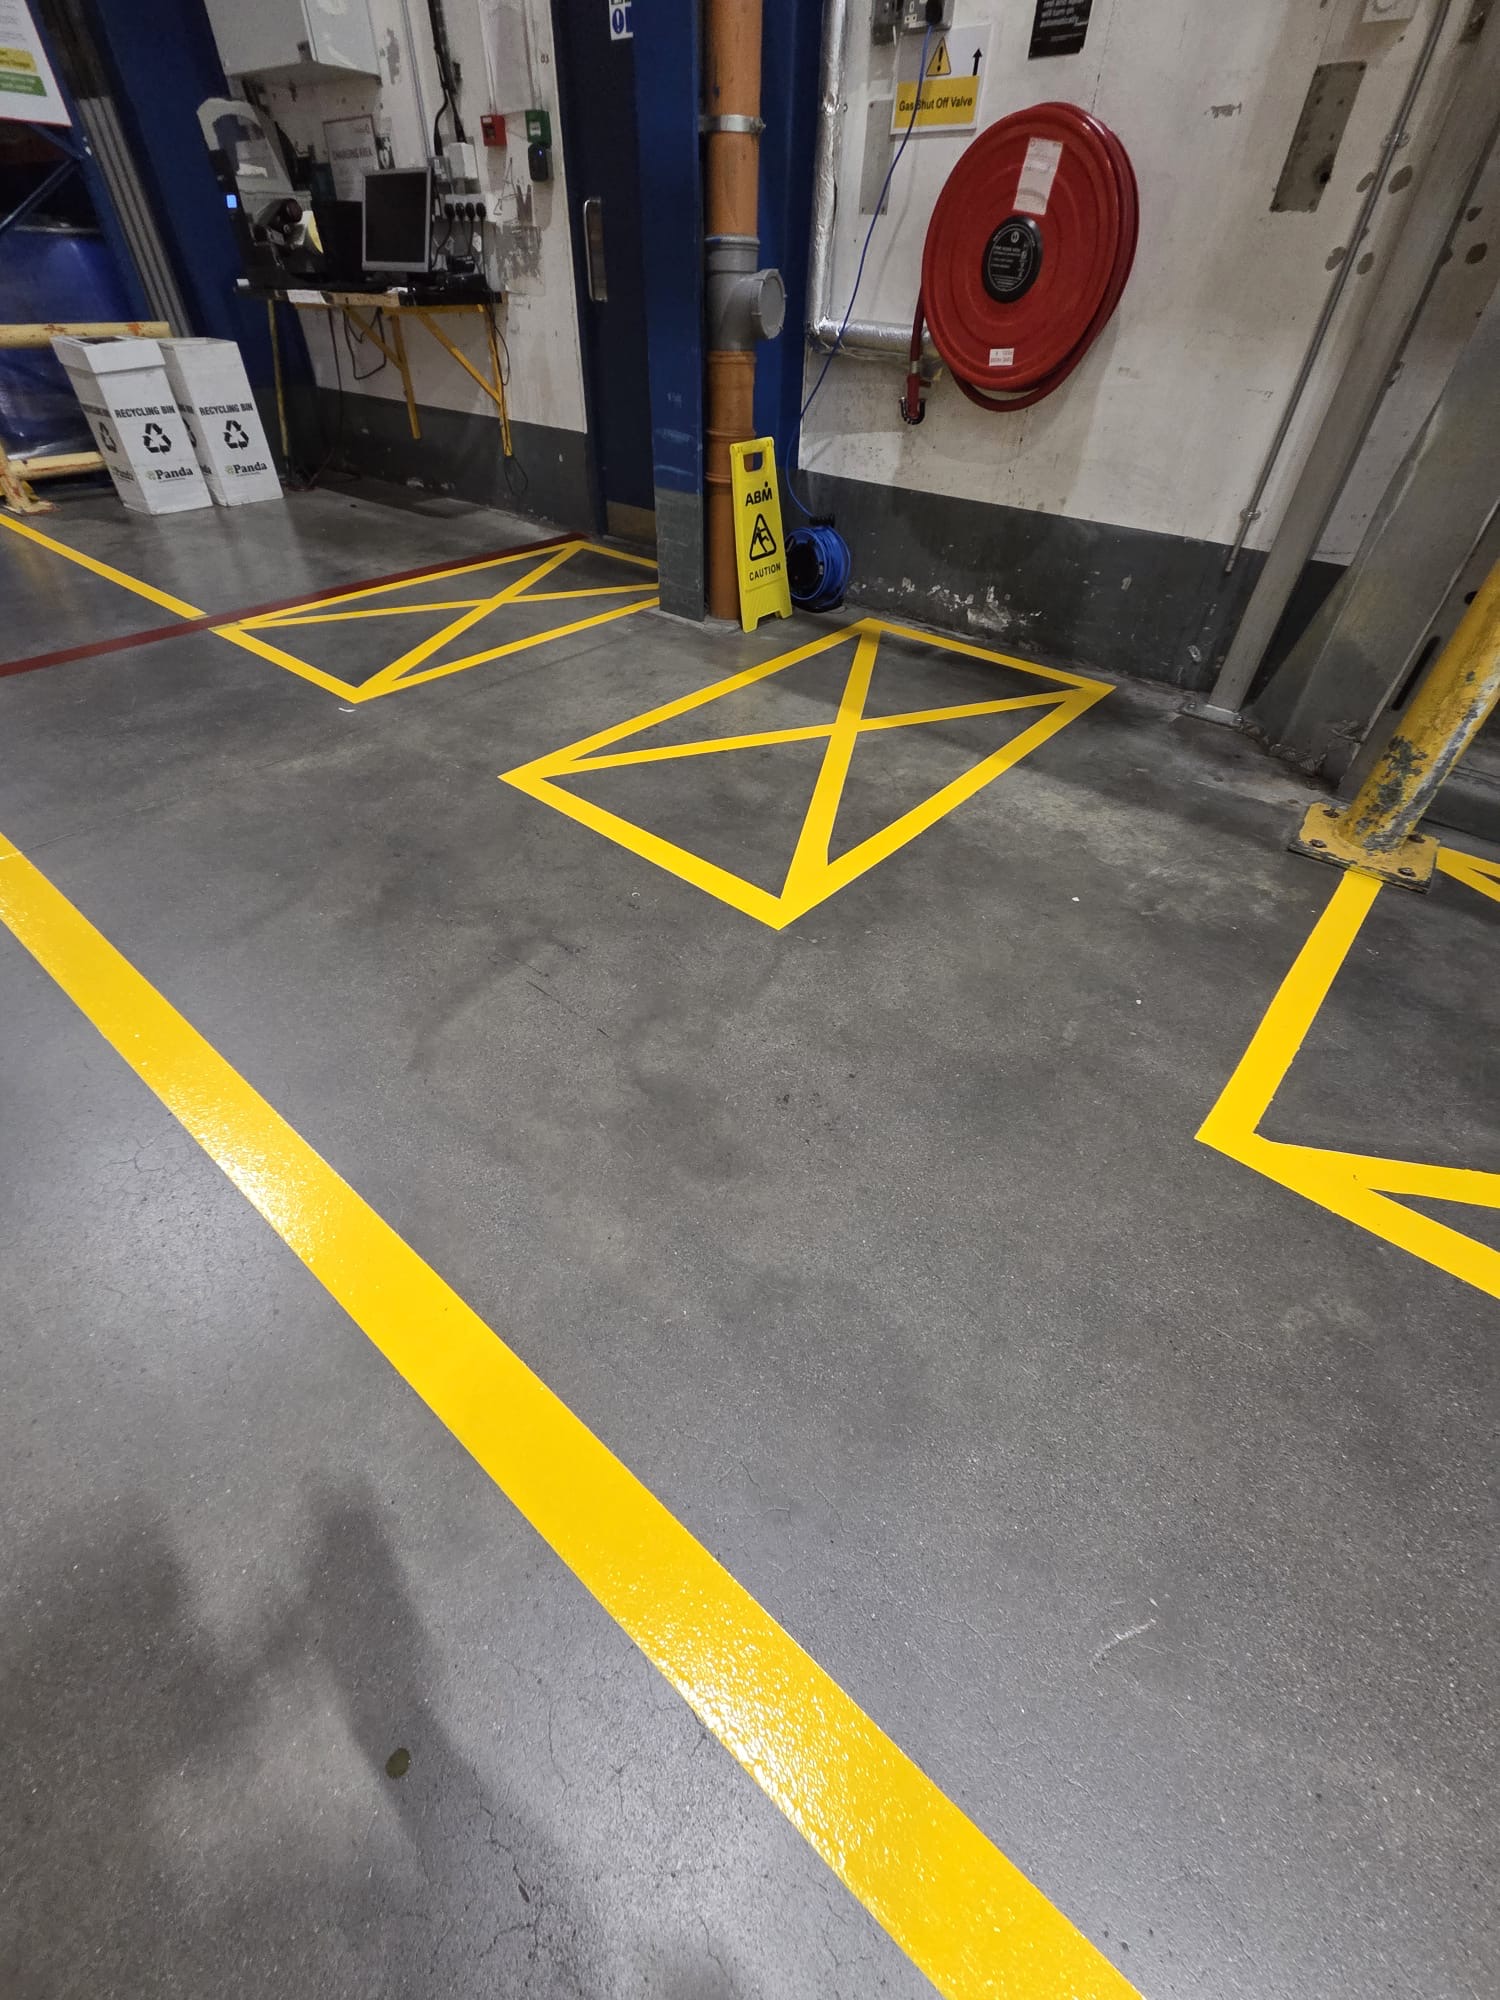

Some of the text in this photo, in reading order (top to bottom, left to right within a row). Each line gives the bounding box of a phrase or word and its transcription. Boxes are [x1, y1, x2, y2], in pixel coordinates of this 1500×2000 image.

[899, 101, 914, 112] Gas
[936, 97, 950, 109] Off
[951, 96, 973, 108] Valve
[114, 406, 161, 418] RECYCLING
[160, 405, 176, 415] BIN
[199, 403, 240, 416] RECYCLING
[240, 402, 254, 412] BIN
[155, 466, 193, 480] Panda
[233, 461, 268, 474] Panda
[745, 485, 773, 507] ABM
[749, 562, 781, 581] CAUTION
